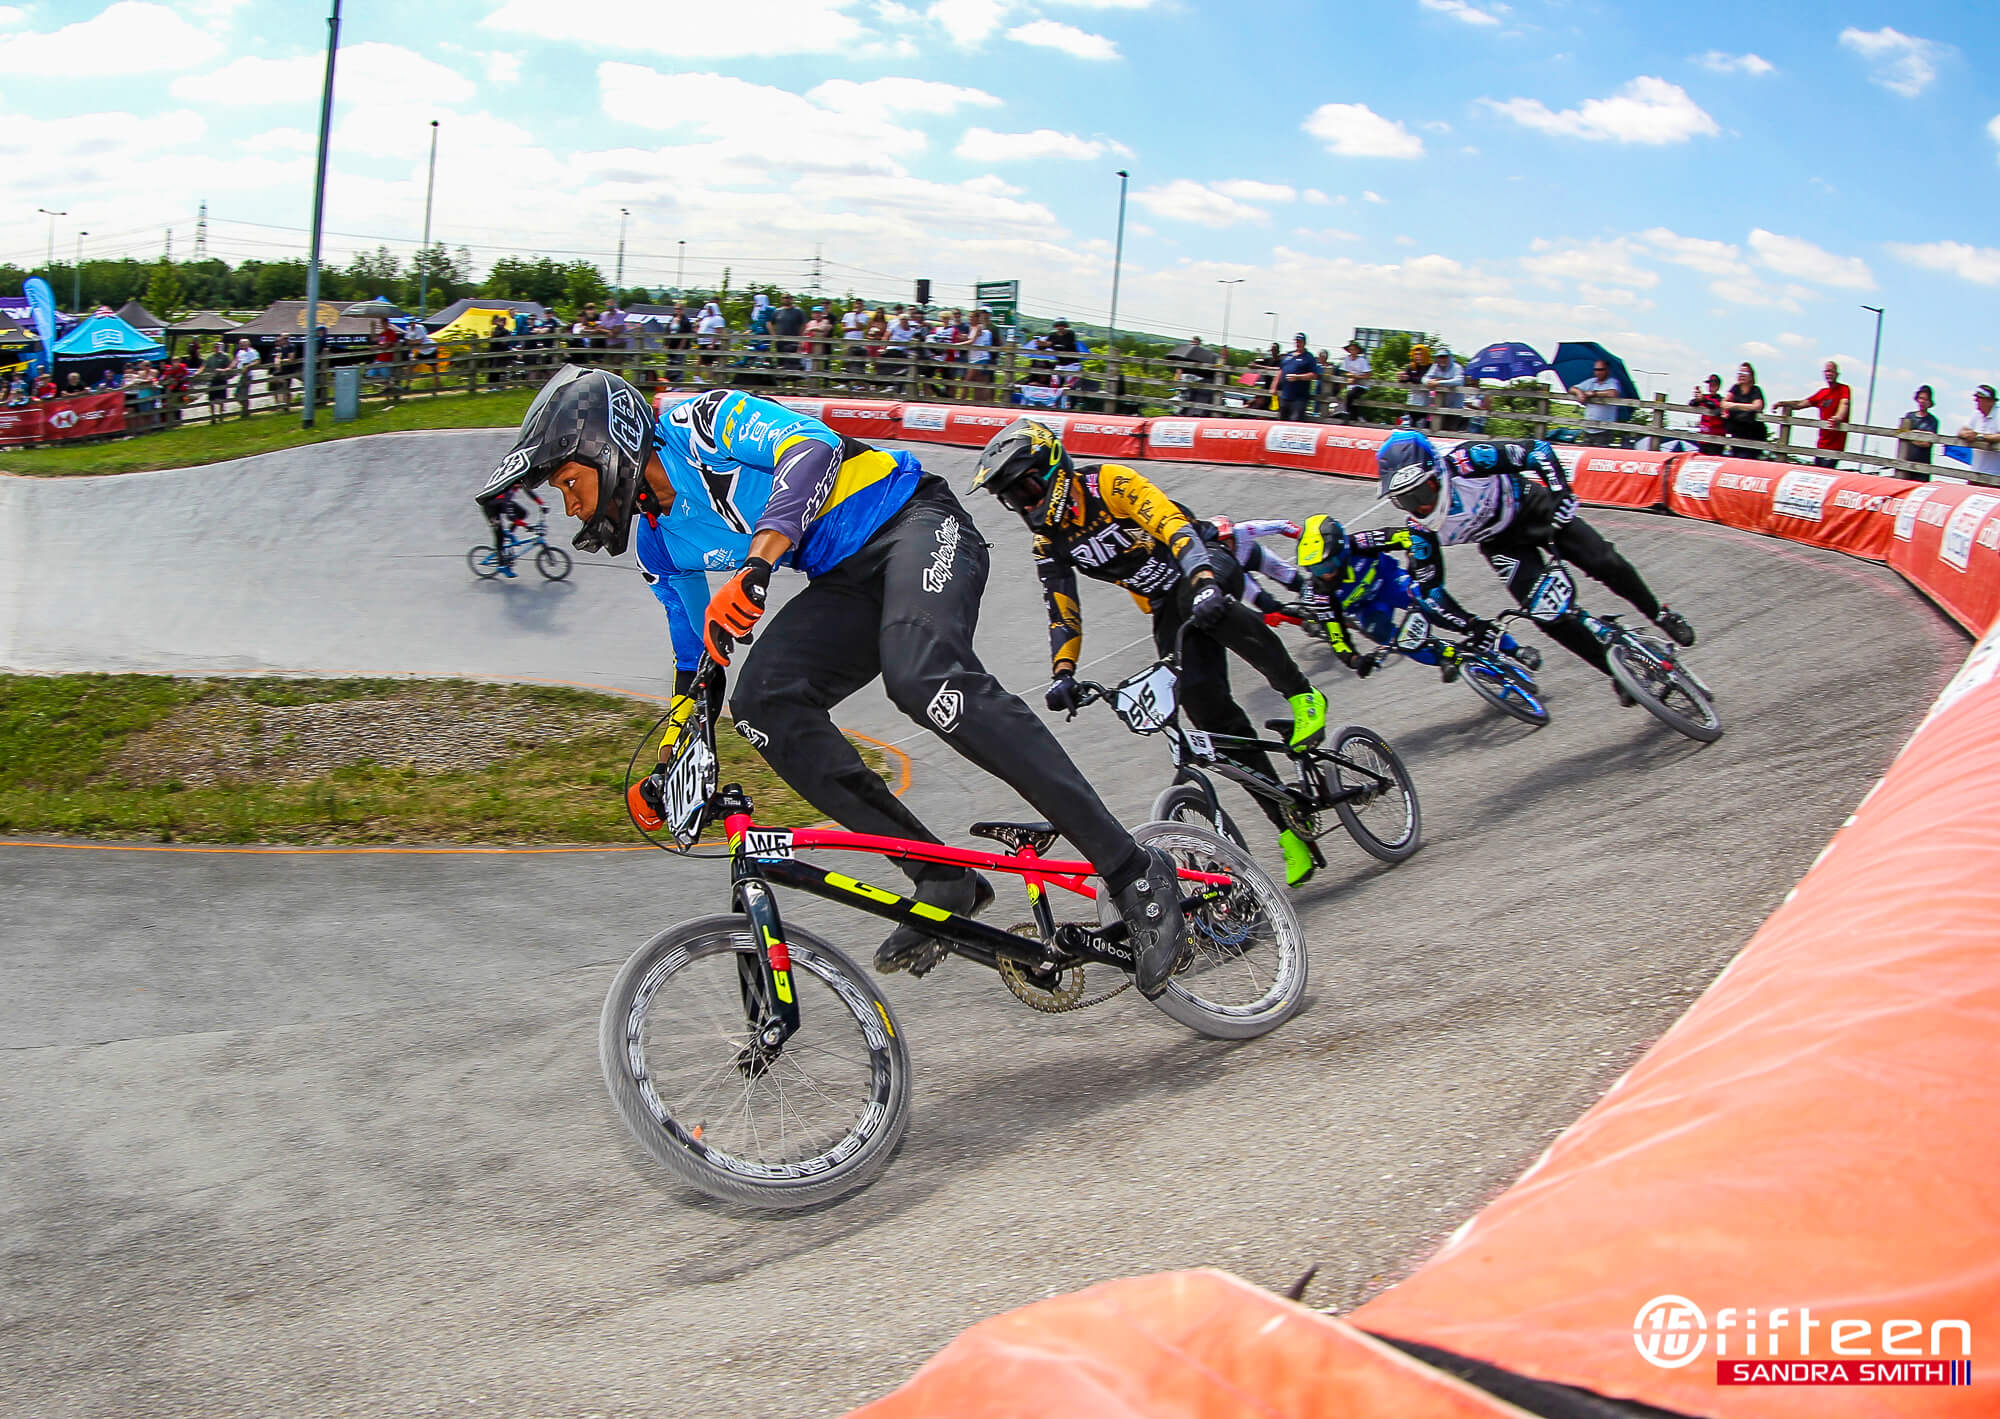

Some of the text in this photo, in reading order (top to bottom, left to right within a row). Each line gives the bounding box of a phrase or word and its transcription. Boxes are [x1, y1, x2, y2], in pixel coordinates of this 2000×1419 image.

[1070, 522, 1132, 569] RIFT
[1129, 681, 1157, 728] 55
[669, 748, 697, 826] W5
[748, 833, 790, 857] W5
